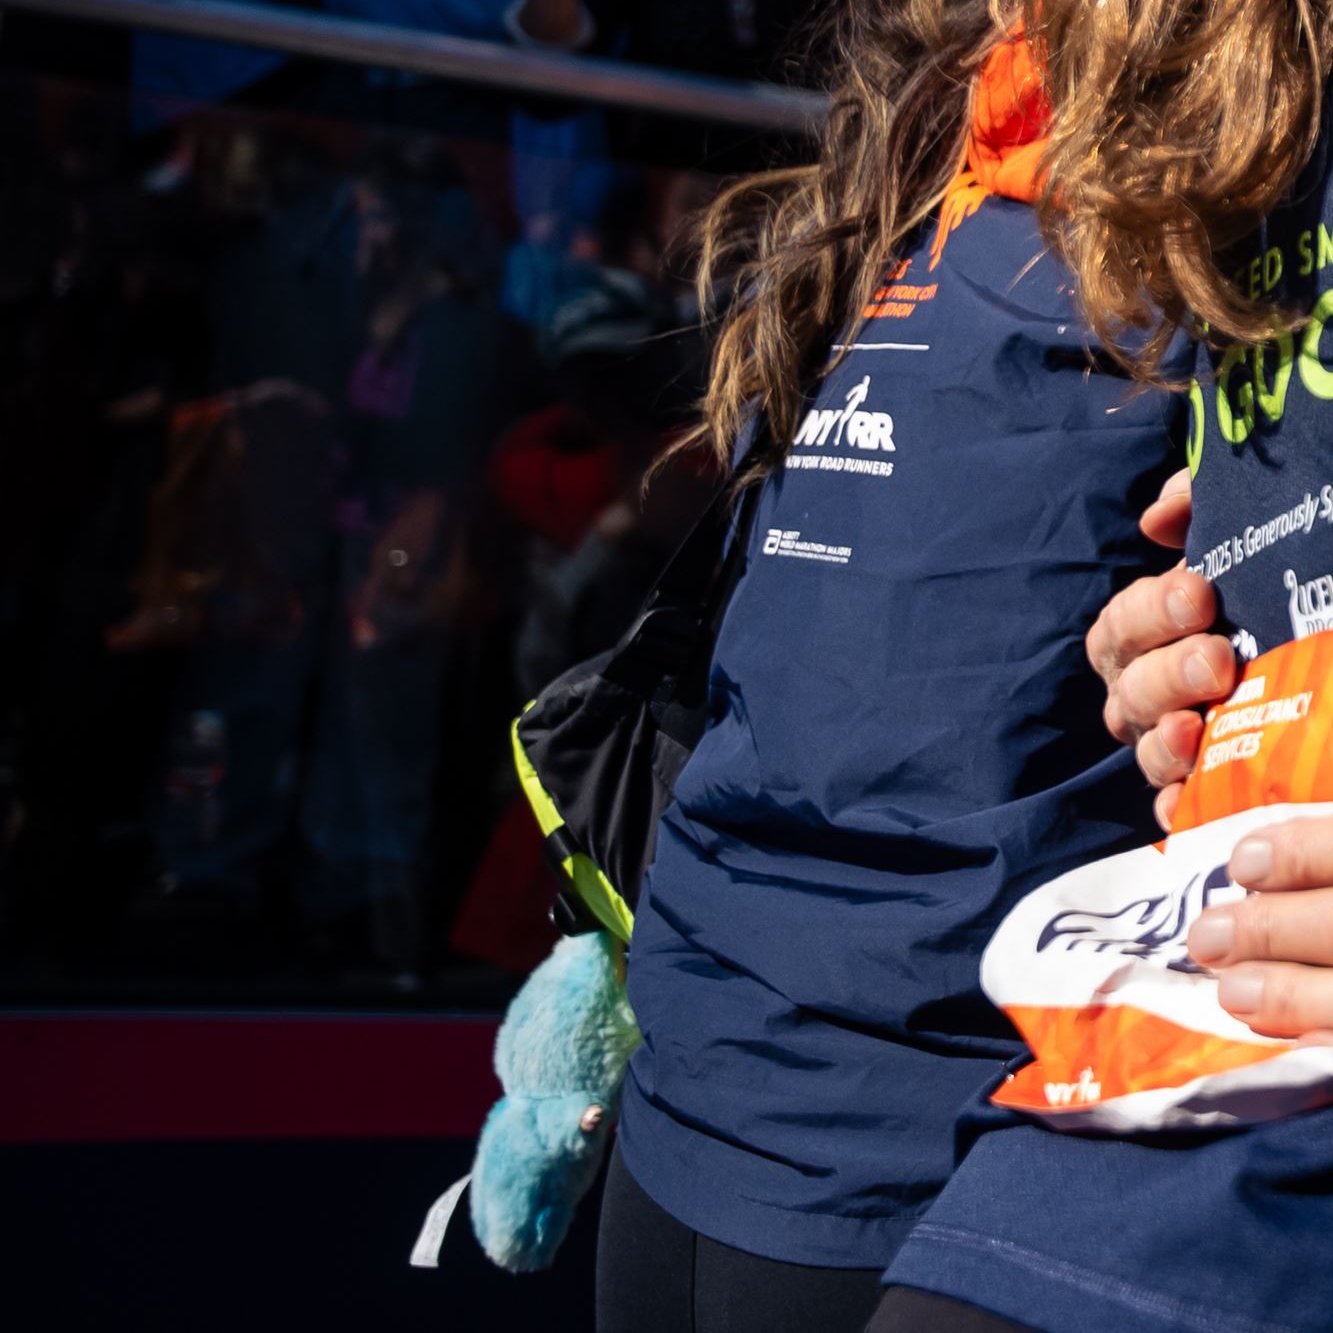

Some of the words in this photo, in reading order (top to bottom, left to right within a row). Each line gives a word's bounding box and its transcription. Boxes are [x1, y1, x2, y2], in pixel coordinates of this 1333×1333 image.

[820, 456, 844, 472] ROAD
[844, 458, 894, 477] RUNNERS
[1203, 540, 1232, 582] 2025
[1243, 493, 1320, 556] Generously
[1210, 691, 1314, 740] CONSULTANCY
[1202, 730, 1264, 773] SERVICES
